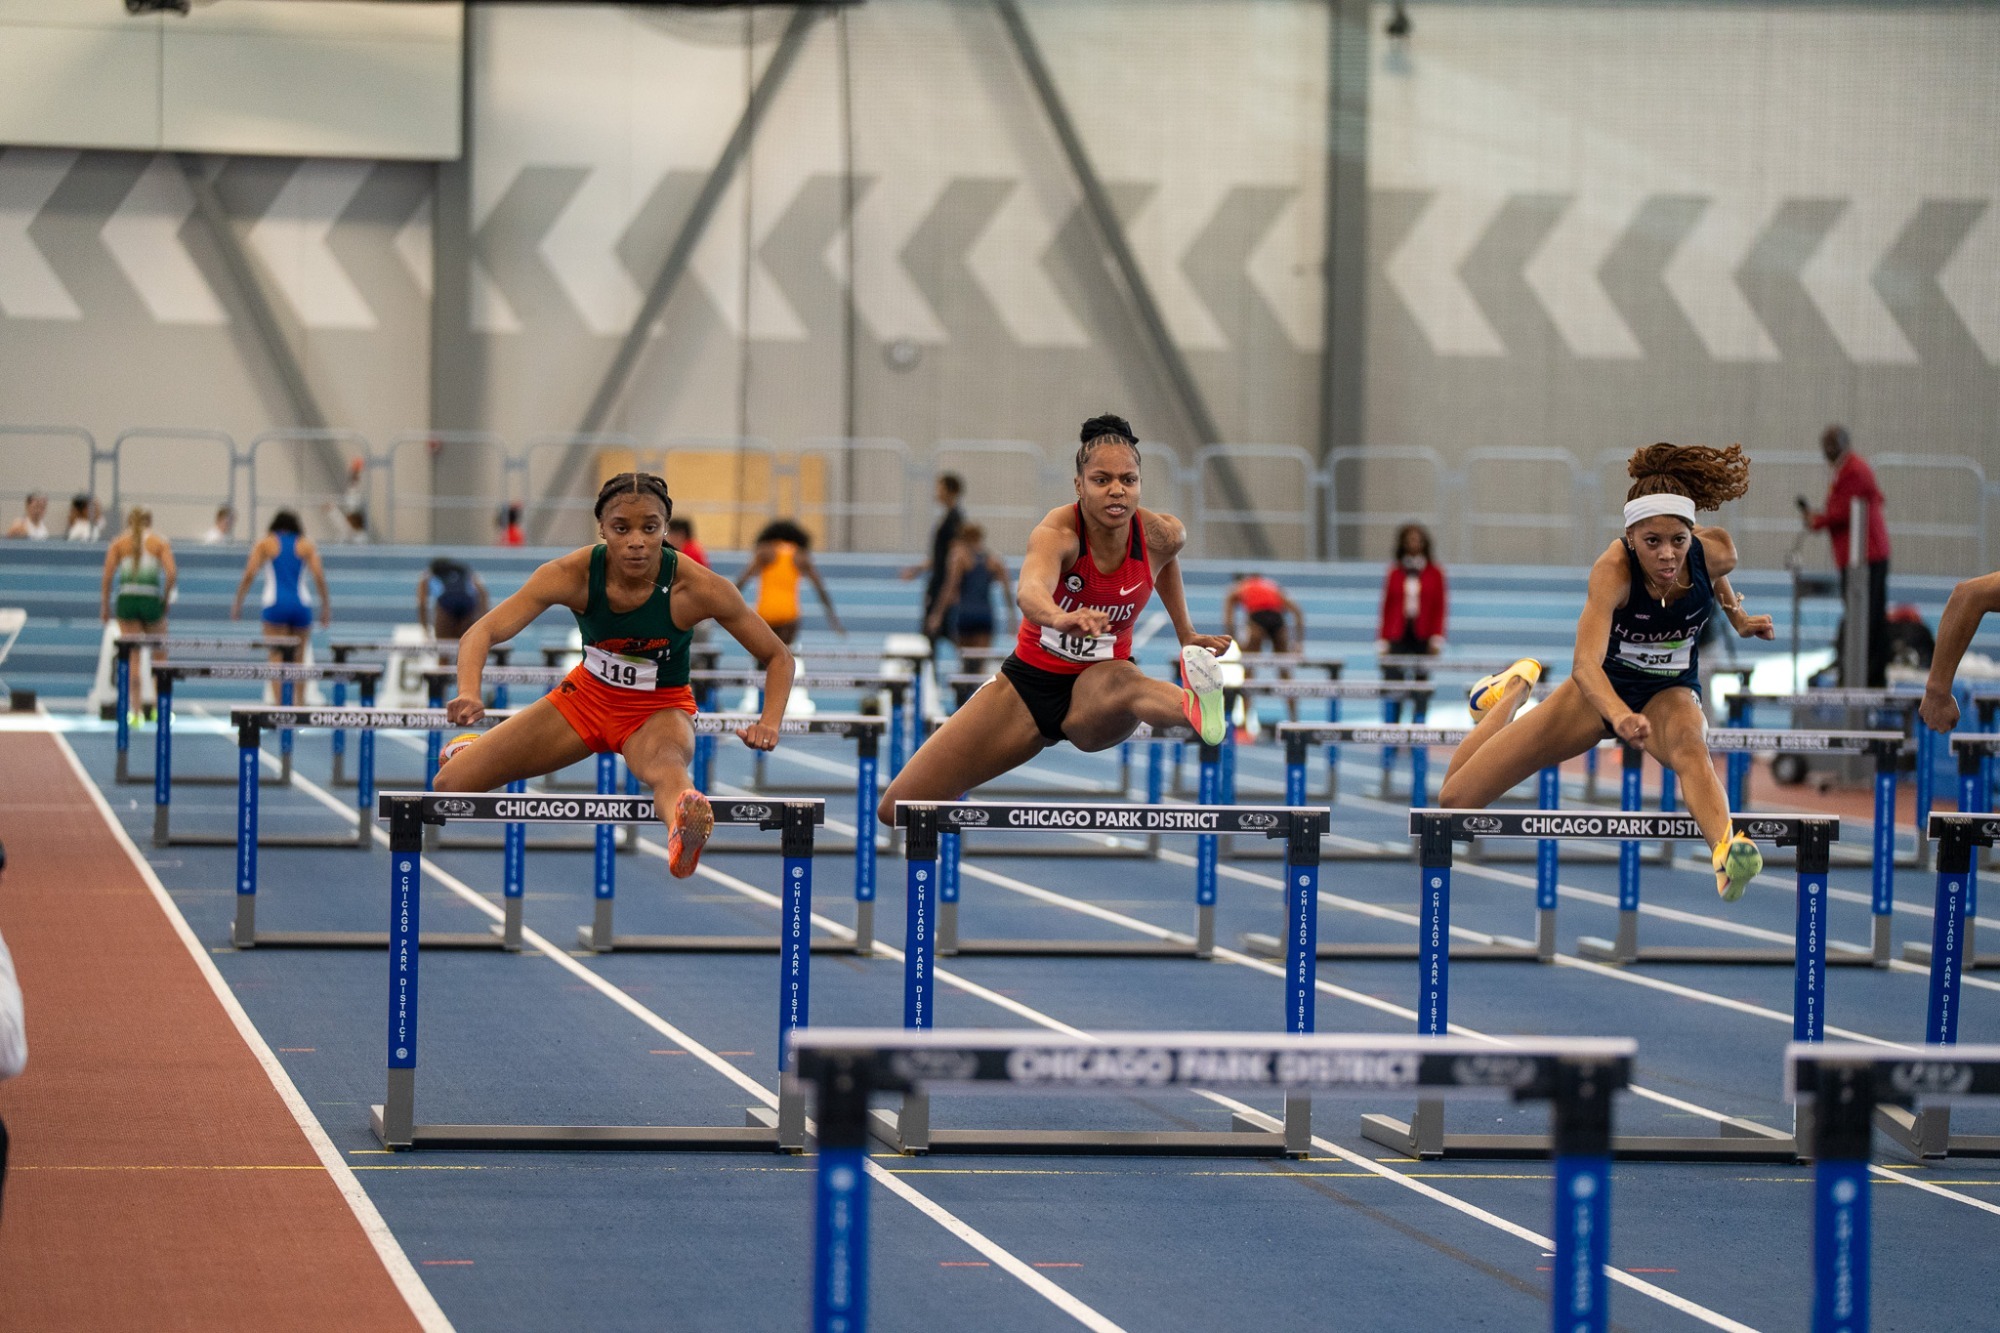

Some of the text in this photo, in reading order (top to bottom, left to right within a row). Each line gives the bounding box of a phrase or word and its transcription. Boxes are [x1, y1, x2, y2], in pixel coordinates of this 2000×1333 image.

[1058, 633, 1098, 657] 192
[600, 660, 637, 686] 119
[310, 712, 368, 727] CHICAGO
[371, 713, 404, 727] PARK
[495, 800, 579, 818] CHICAGO
[584, 802, 633, 819] PARK
[1008, 809, 1219, 829] CHICAGO PARK DISTRICT
[1521, 817, 1703, 836] CHICAGO PARK DISTR
[401, 876, 409, 933] CHICAGO
[793, 882, 801, 938] CHICAGO
[917, 885, 925, 941] CHICAGO
[1300, 890, 1308, 946] CHICAGO
[1432, 892, 1440, 947] CHICAGO
[1946, 896, 1956, 951] CHICAGO
[400, 939, 408, 972] PARK
[792, 944, 800, 976] PARK
[916, 947, 924, 979] PARK
[1299, 952, 1307, 984] PARK
[1431, 953, 1439, 985] PARK
[1808, 959, 1816, 991] PARK
[1943, 957, 1952, 988] PARK
[399, 978, 407, 1042] DISTRICT
[1939, 994, 1949, 1049] DISTRIC
